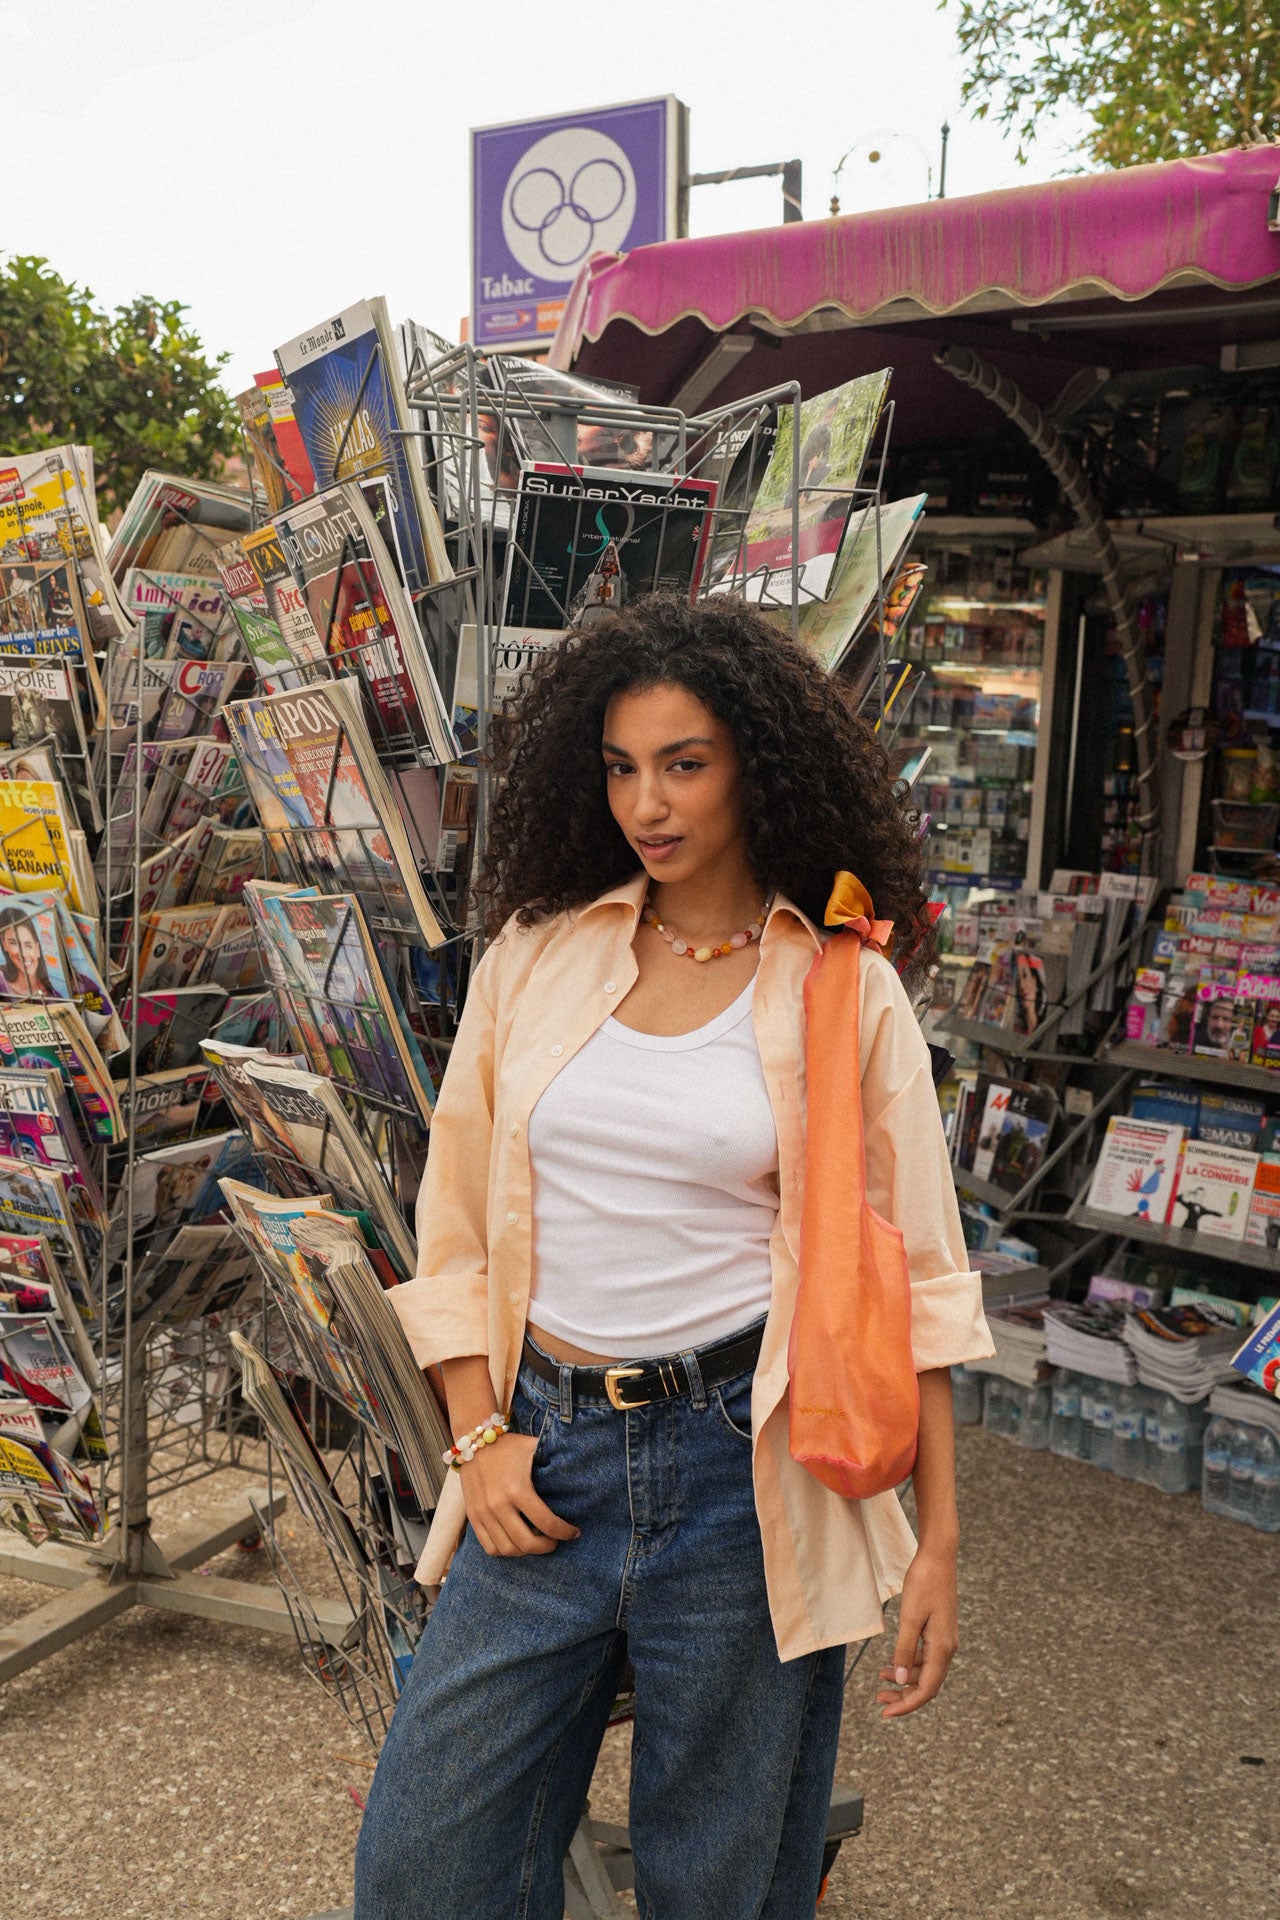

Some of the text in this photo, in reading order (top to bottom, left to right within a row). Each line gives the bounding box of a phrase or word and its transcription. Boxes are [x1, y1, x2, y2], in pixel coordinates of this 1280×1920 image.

[482, 273, 536, 299] Tabac
[300, 341, 308, 355] Le
[306, 330, 333, 351] Monde
[282, 508, 365, 569] DIPLOMATIE
[582, 532, 641, 544] international
[522, 635, 541, 646] Vivre
[360, 635, 404, 681] CHINE
[267, 694, 340, 750] JAPON
[7, 848, 36, 859] AVOIR
[12, 1031, 66, 1045] cerveau
[1186, 1165, 1250, 1186] LA CONNERIE
